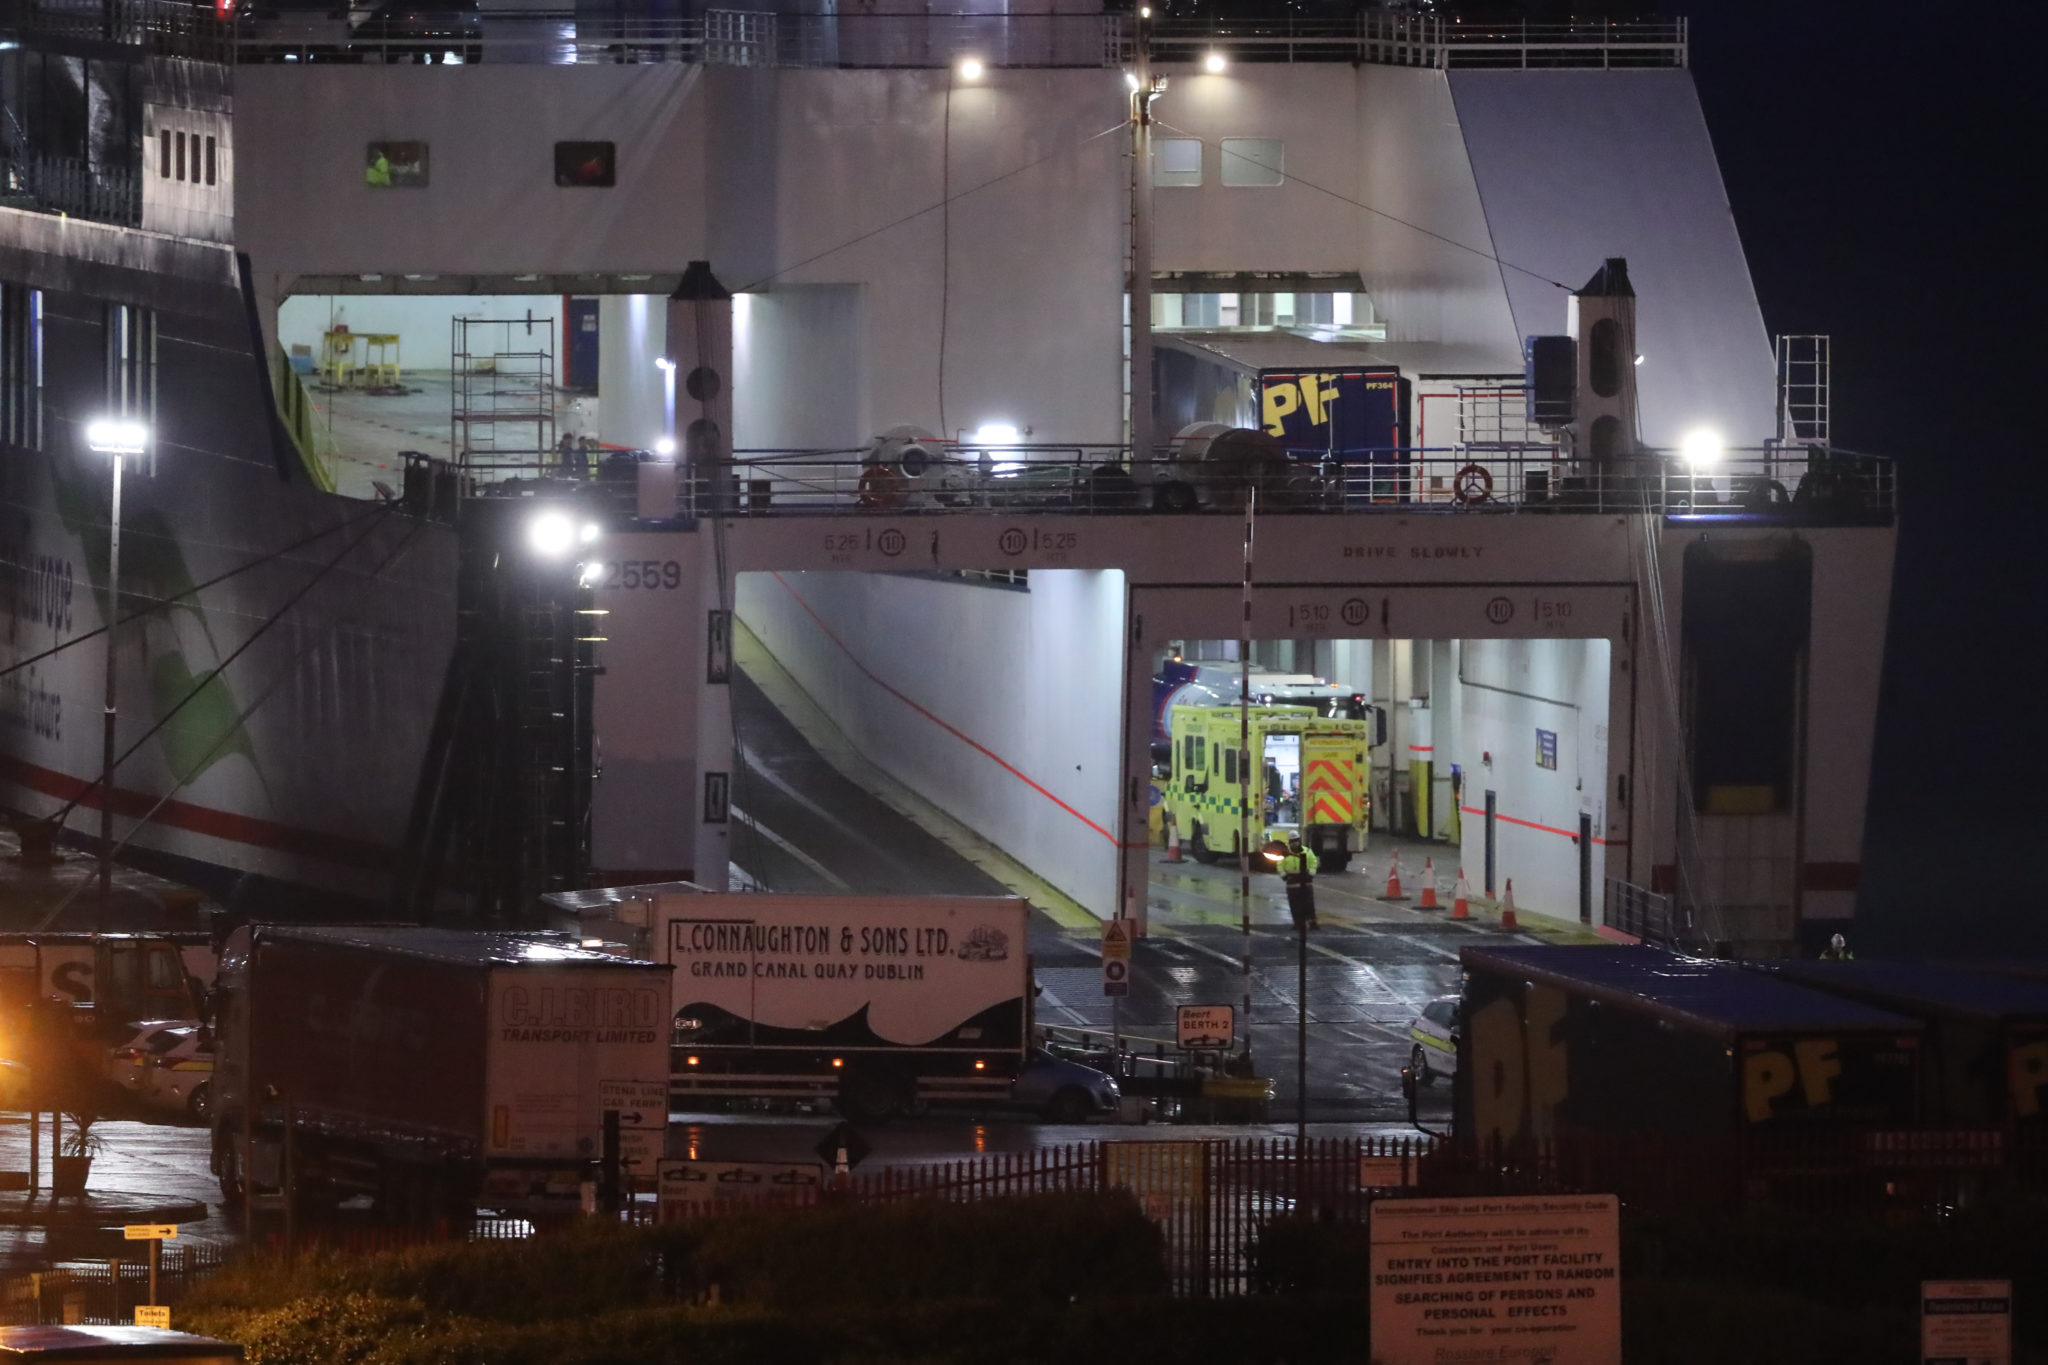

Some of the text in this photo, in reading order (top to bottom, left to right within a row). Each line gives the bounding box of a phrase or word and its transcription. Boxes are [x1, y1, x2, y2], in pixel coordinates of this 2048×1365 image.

[1263, 373, 1340, 437] PF
[885, 535, 900, 550] 10
[1006, 535, 1021, 549] 10
[1344, 546, 1482, 559] DRIVE SLOWLY
[602, 560, 681, 590] 2559
[1348, 605, 1363, 619] 10
[1493, 603, 1508, 618] 10
[840, 926, 853, 953] &
[860, 927, 908, 954] SONS
[916, 927, 954, 955] LTD.
[691, 961, 924, 980] GRAND CANAL QUAY DUBLIN
[1183, 1021, 1229, 1029] BERTH 2
[502, 1028, 657, 1044] TRANSPORT LIMITED
[1744, 1040, 1842, 1123] PF
[602, 1086, 665, 1097] STENA LINE
[603, 1098, 663, 1108] CAR FERRY
[620, 1134, 643, 1143] RISH
[1401, 1231, 1419, 1239] The
[1422, 1230, 1443, 1239] Port
[1445, 1229, 1488, 1240] Authority
[1388, 1253, 1603, 1270] ENTRY INTO THE PORT FACILITY
[1375, 1268, 1615, 1286] SIGNIFIES AGREEMENT TO RANDOM
[1394, 1287, 1595, 1304] SEARCHING OF PERSONS AND
[1424, 1305, 1568, 1320] PERSONAL EFFECTS
[1416, 1327, 1446, 1336] Thank
